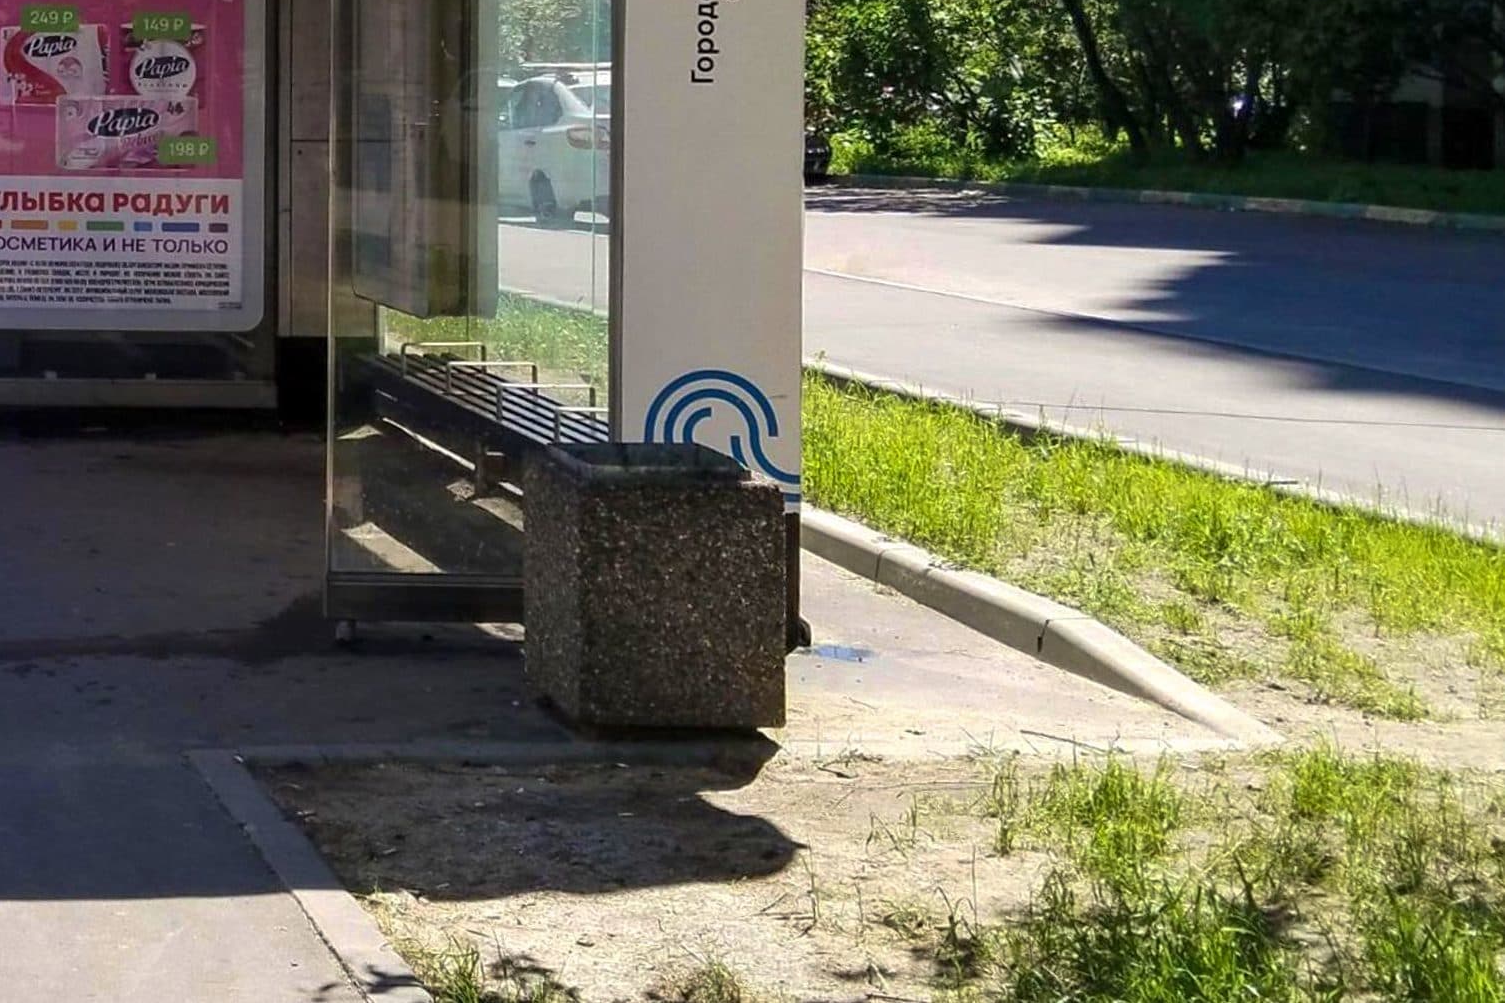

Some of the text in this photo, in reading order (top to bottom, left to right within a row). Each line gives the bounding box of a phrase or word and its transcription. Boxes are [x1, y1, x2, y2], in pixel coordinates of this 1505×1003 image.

[30, 11, 58, 25] 249
[143, 18, 168, 32] 149
[26, 34, 75, 57] Papia
[138, 56, 189, 79] Papia
[91, 106, 158, 138] Papia
[169, 143, 194, 157] 198
[103, 237, 116, 252] И
[122, 238, 145, 253] НЕ
[152, 239, 229, 255] ТОЛЬКО
